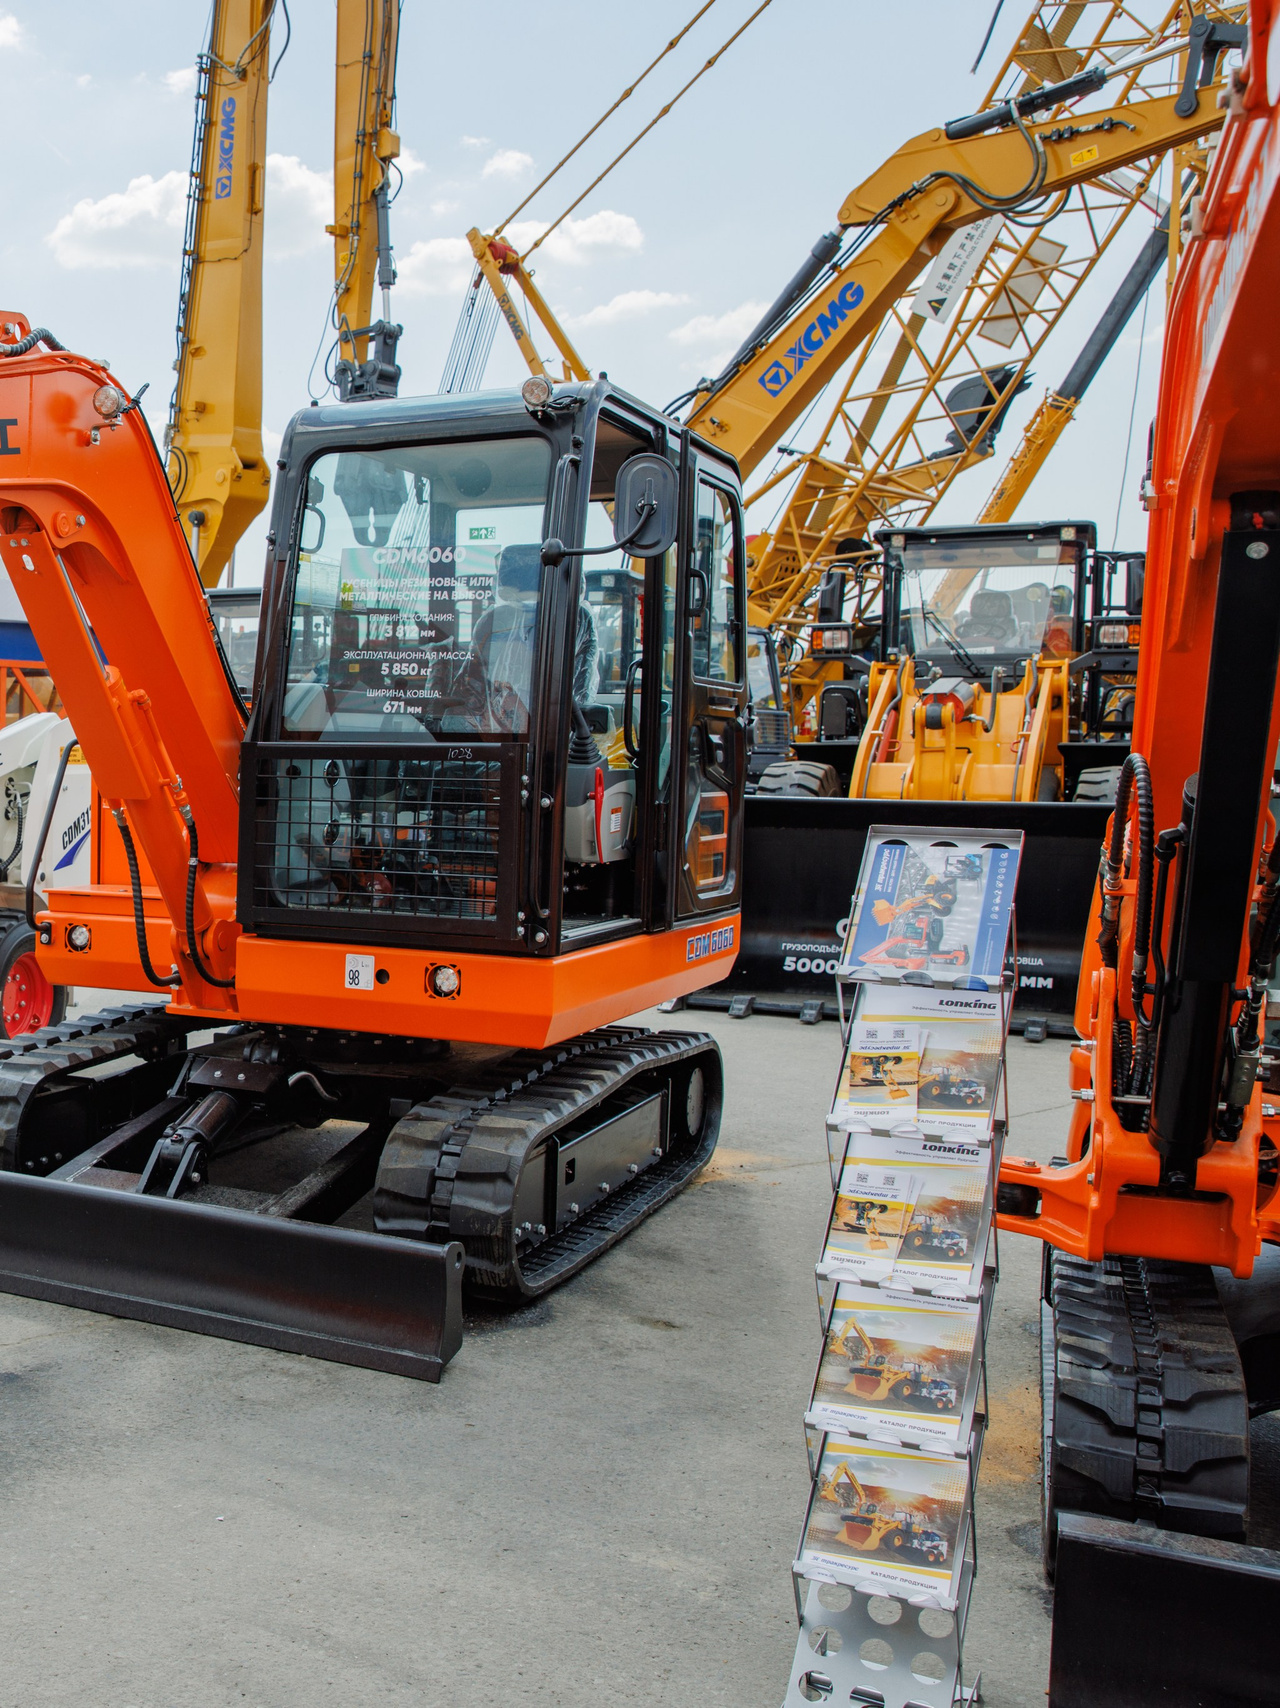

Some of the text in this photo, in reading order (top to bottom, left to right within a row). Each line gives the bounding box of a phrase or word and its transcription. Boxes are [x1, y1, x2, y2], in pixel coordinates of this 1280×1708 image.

[218, 96, 236, 174] XCMG
[935, 213, 985, 292] 起重臂下严禁站
[503, 306, 524, 340] XCMG
[783, 281, 865, 376] XCMG
[372, 547, 467, 564] CDM6060
[400, 577, 467, 588] РЕЗИНОВЫЕ
[468, 576, 494, 587] ИЛИ
[339, 590, 493, 601] МЕТАЛЛИЧЕСКИЕ НА ВЫБОР
[369, 614, 455, 622] ГЛУБИНА КОПАНИЯ:
[384, 625, 393, 637] 3
[395, 625, 419, 637] 812
[343, 651, 475, 661] ЭКСПЛУАТАЦИОННАЯ МАССА:
[380, 663, 432, 676] 5 850 кг
[366, 689, 442, 698] ШИРИНА КОВША:
[383, 701, 422, 714] 671 мм
[62, 804, 91, 850] CDM31
[781, 943, 842, 954] ГРУЗОПОДЪЁМ
[348, 969, 361, 986] 98
[938, 998, 998, 1010] LONKING
[921, 1144, 980, 1156] LONKING
[920, 1272, 958, 1281] ПРОДУКЦИИ
[880, 1419, 947, 1435] КАТАЛОГ ПРОДУКЦИИ
[870, 1571, 938, 1590] КАТАЛОГ ПРОДУКЦИИ
